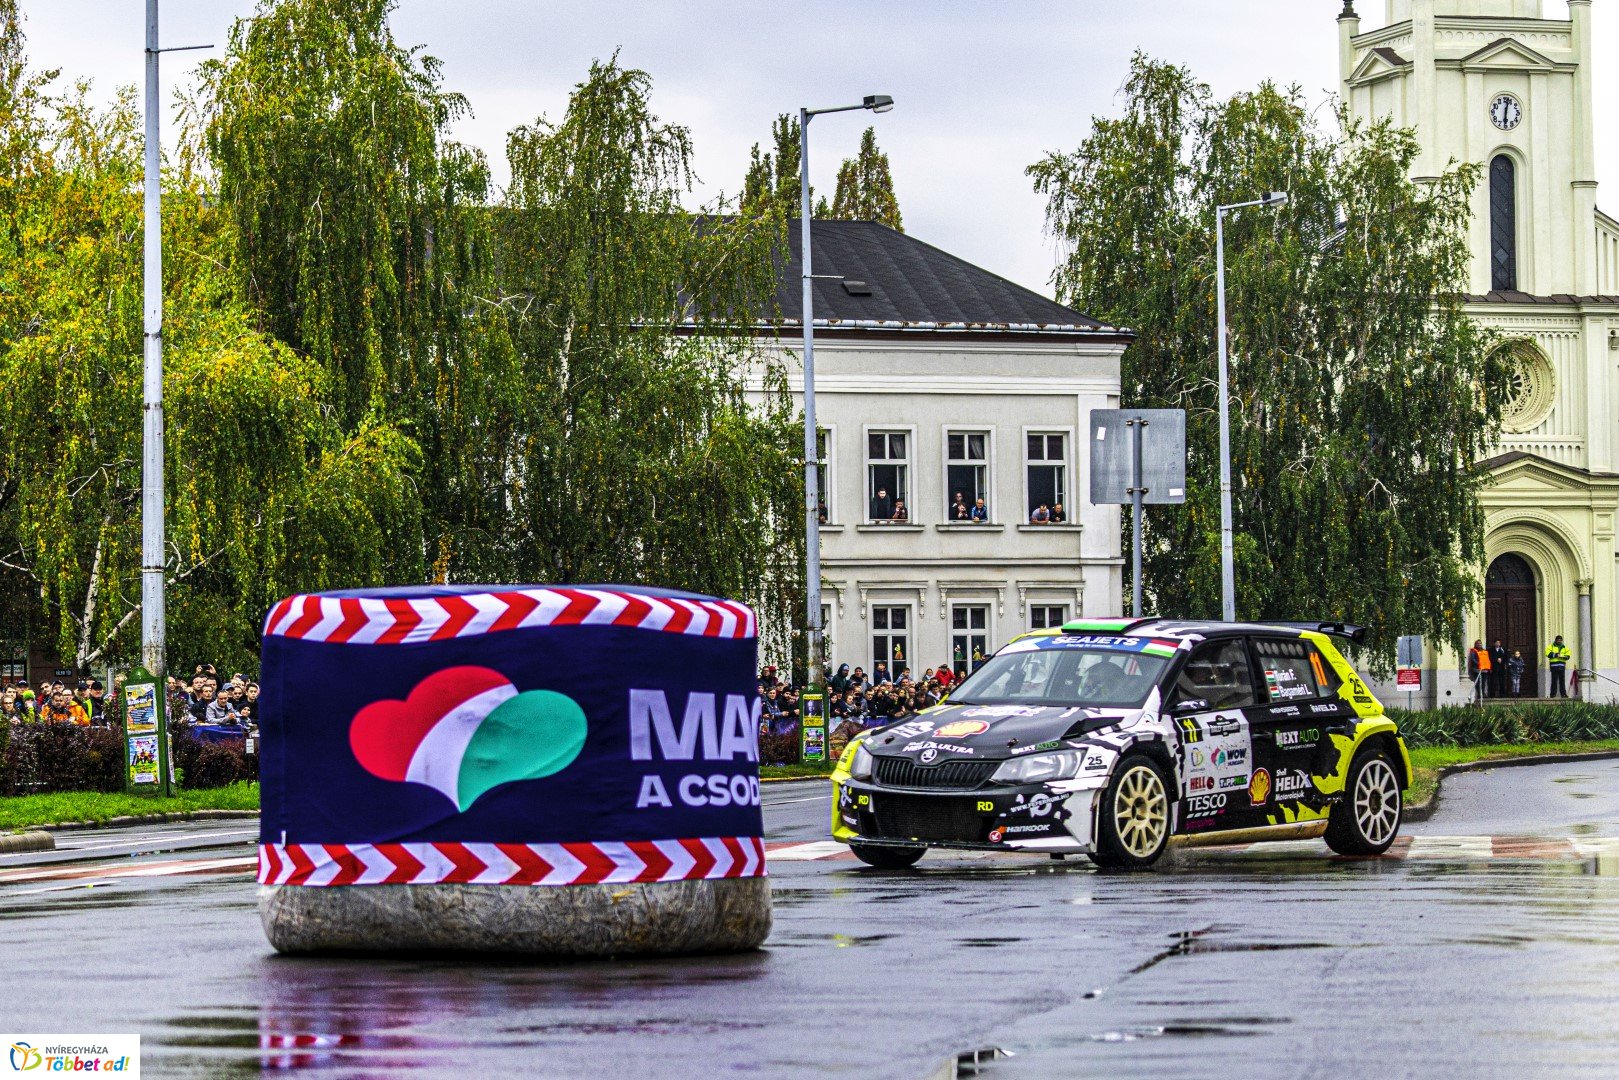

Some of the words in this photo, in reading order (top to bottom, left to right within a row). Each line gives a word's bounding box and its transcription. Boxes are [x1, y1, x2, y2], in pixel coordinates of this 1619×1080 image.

[1052, 636, 1139, 646] SEAJETS
[1350, 678, 1364, 694] 25
[1183, 718, 1198, 743] 11
[1087, 755, 1103, 766] 25
[1227, 748, 1247, 760] WOW
[1190, 776, 1206, 790] HELL
[1275, 769, 1313, 792] HELIX
[636, 774, 673, 808] A
[858, 794, 869, 805] RD
[977, 801, 994, 811] RD
[1187, 793, 1227, 812] TESCO
